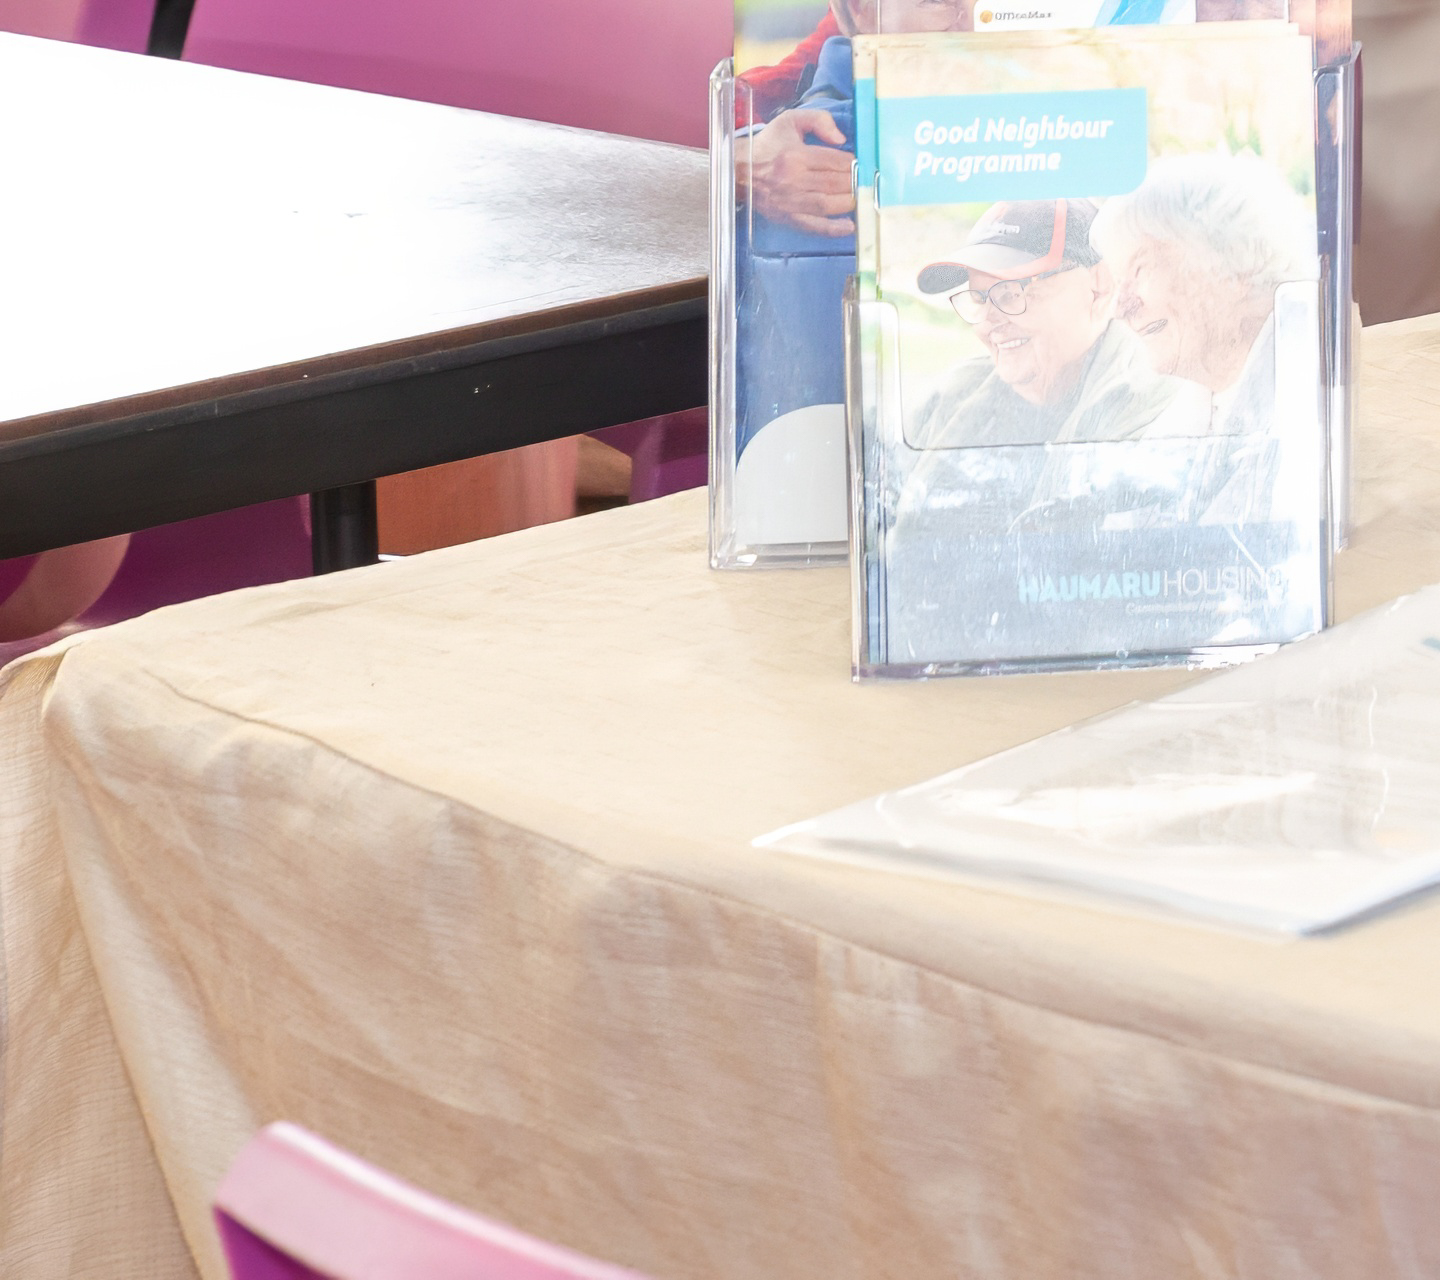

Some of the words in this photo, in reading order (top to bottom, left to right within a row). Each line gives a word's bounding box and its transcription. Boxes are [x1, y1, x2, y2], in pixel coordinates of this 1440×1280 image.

[914, 117, 980, 146] Good
[984, 114, 1114, 149] Neighbour
[914, 151, 1062, 182] Programme
[1018, 569, 1161, 605] HAUMARU
